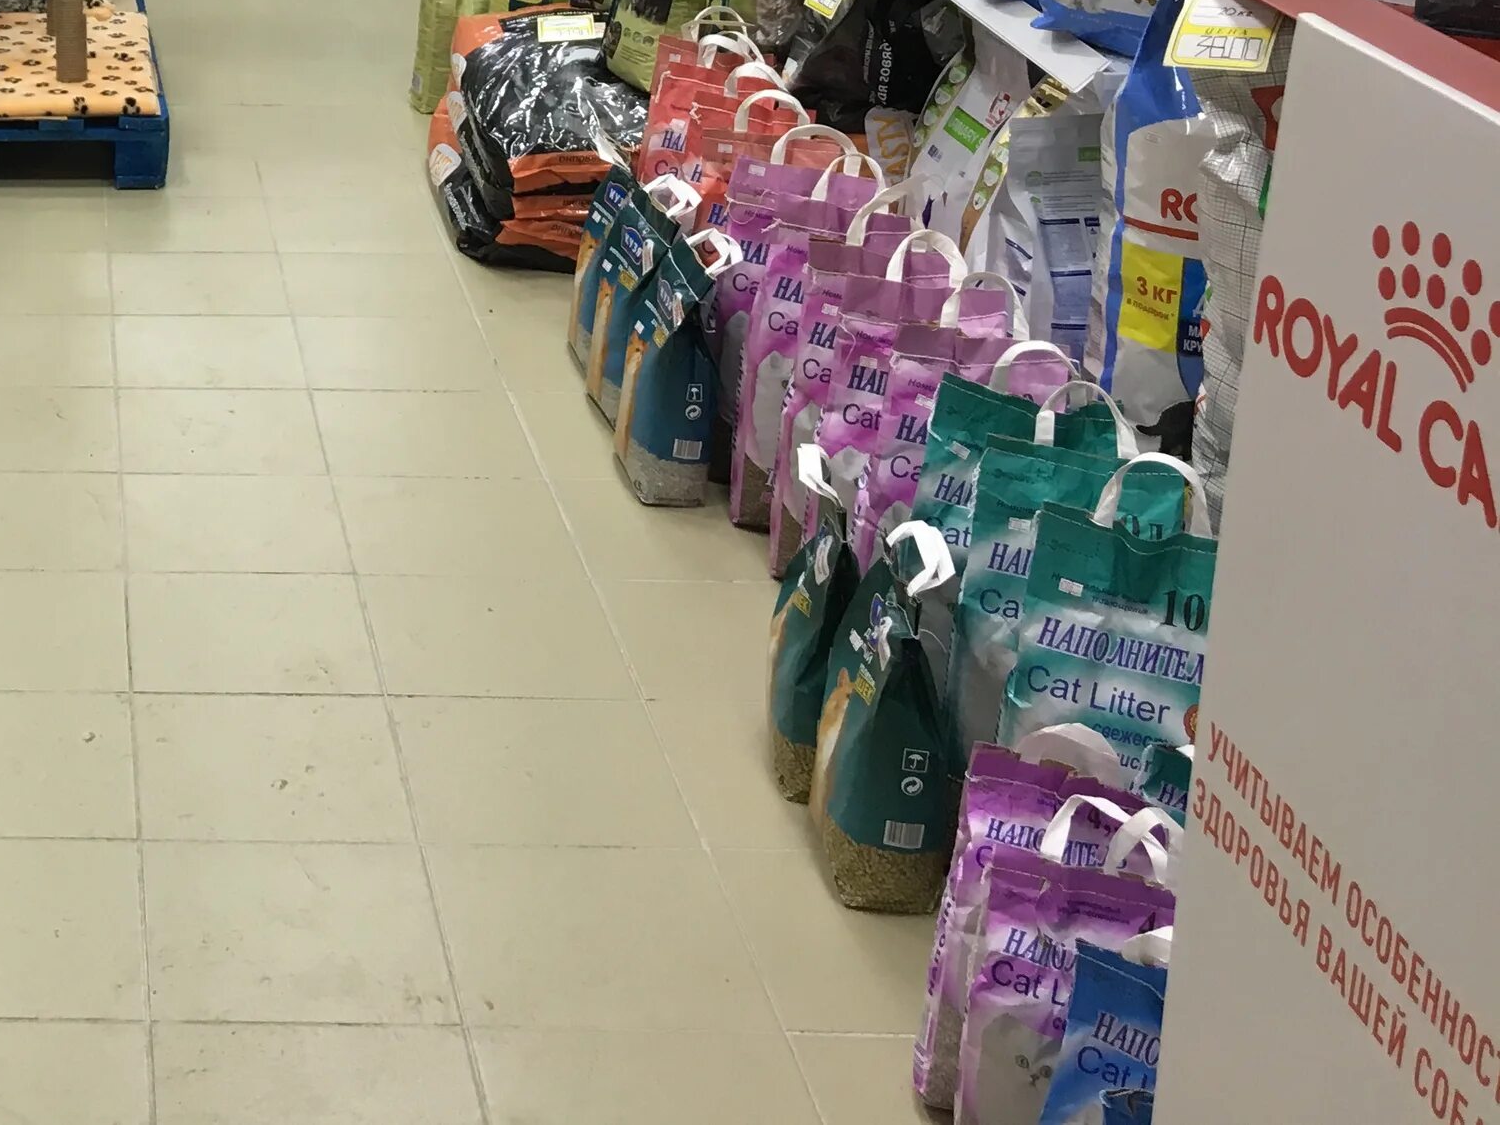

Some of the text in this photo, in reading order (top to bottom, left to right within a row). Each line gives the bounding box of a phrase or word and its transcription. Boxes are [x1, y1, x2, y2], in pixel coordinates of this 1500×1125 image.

[1253, 274, 1402, 453] ROYAL
[842, 403, 883, 431] Cat
[1161, 589, 1205, 632] 10
[1027, 664, 1172, 725] Cat Litter
[1206, 721, 1342, 906] УЧИТЫВАЕМ
[1192, 777, 1312, 947] ЗДОРОВЬЯ
[1315, 923, 1408, 1069] ВАШЕЙ
[990, 960, 1041, 1001] Cat
[1076, 1043, 1132, 1091] Cat
